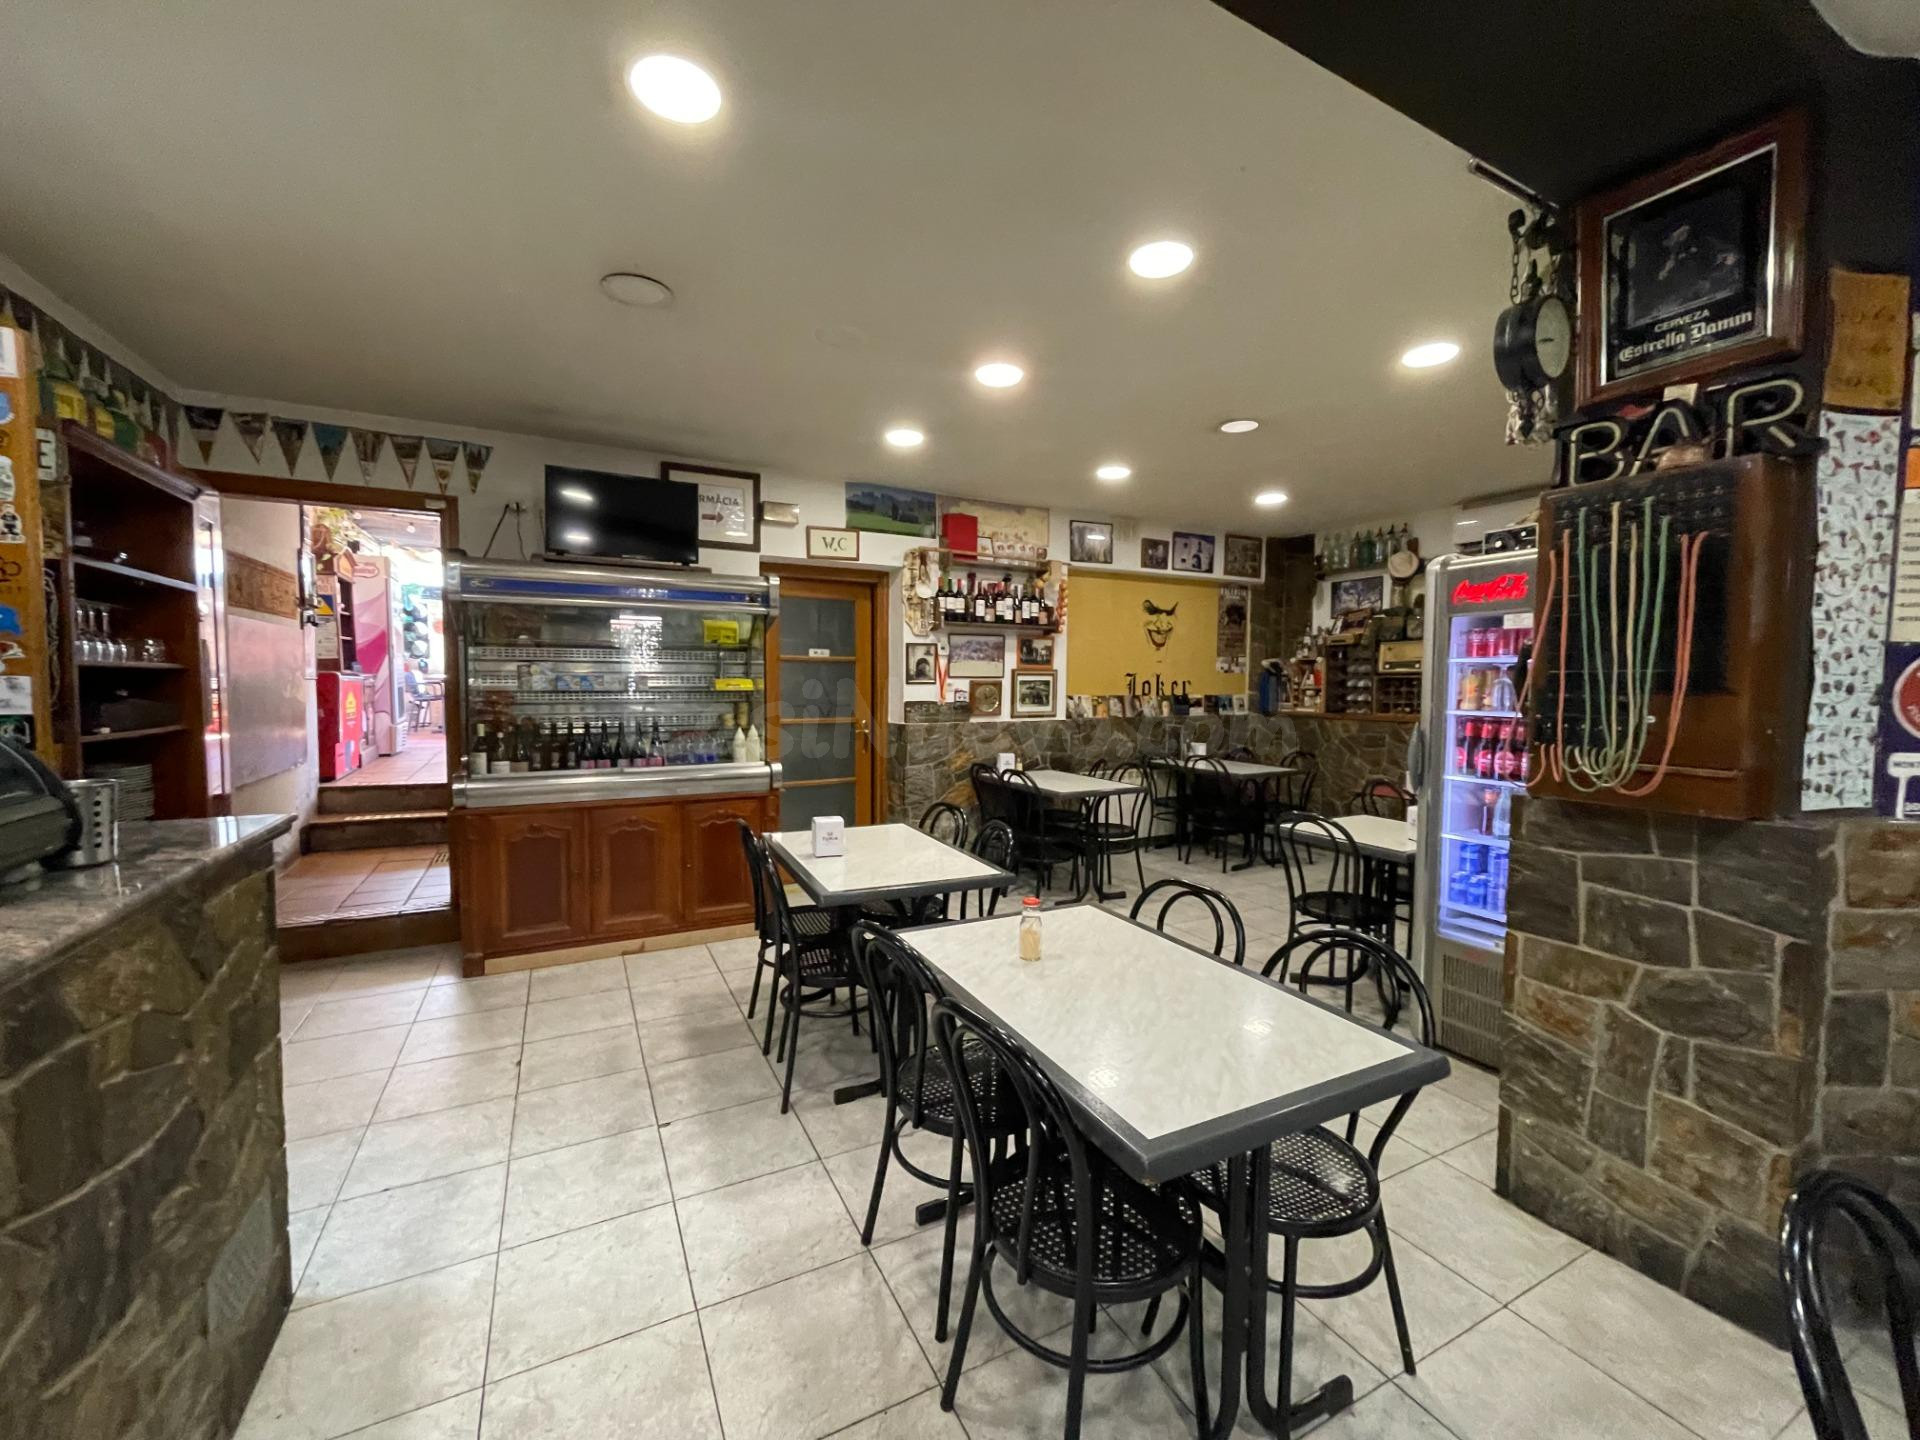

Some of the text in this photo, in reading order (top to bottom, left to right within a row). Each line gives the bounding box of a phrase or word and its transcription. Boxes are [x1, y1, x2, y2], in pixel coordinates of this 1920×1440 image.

[1618, 311, 1754, 362] Estrella Damm
[1654, 308, 1711, 333] CERVEZA
[1568, 378, 1804, 487] BAR
[1124, 672, 1192, 697] Joker
